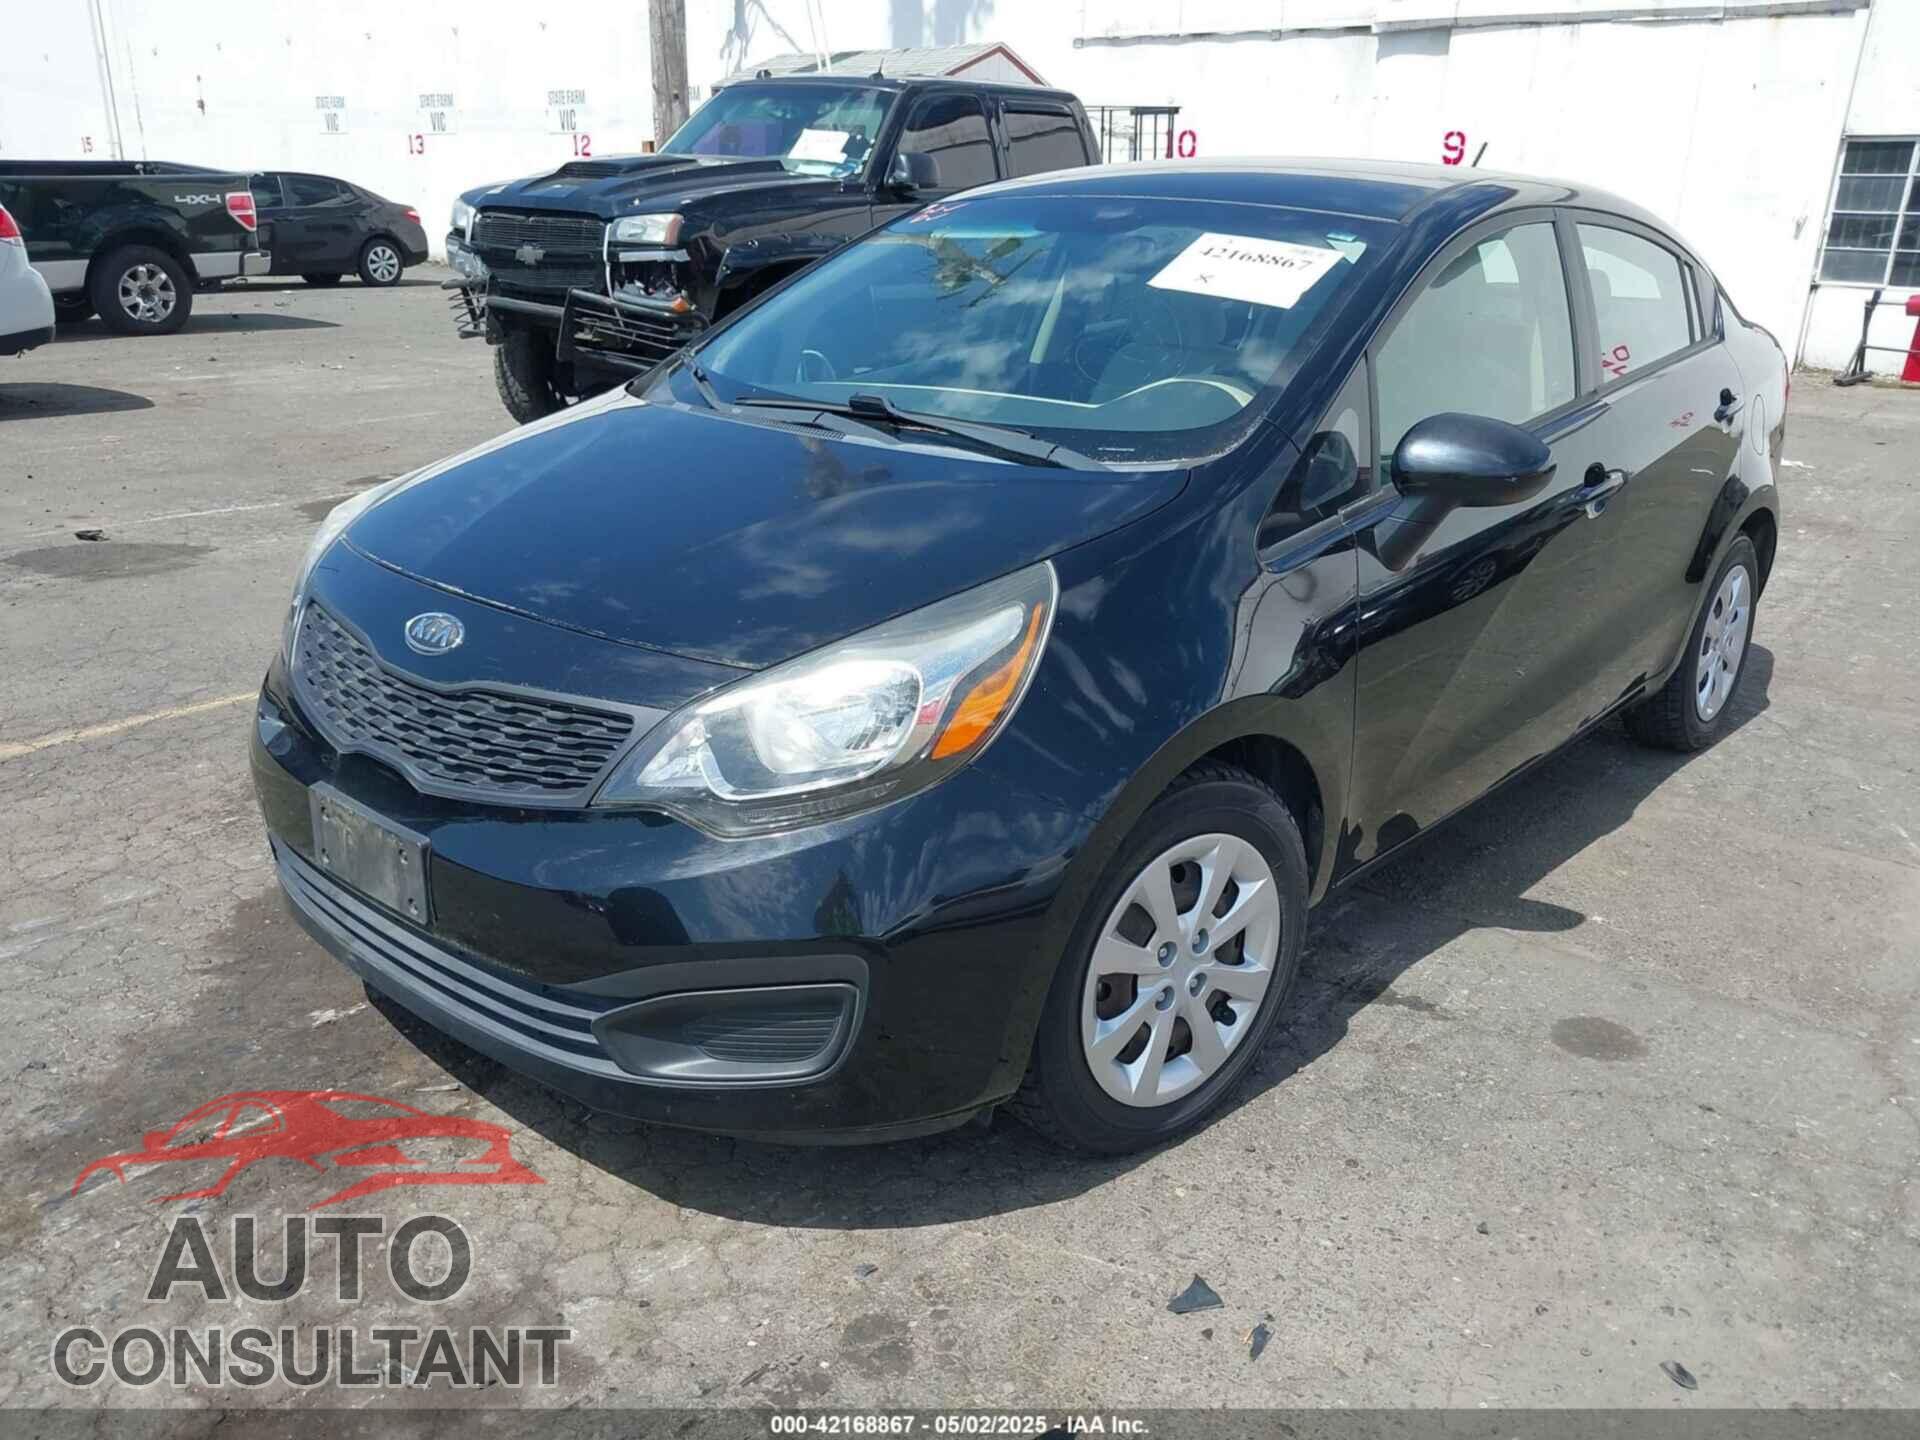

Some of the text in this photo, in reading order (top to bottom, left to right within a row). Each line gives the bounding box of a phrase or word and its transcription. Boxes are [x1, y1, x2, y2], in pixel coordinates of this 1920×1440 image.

[567, 89, 586, 104] FARM
[324, 112, 339, 132] VIC
[430, 111, 446, 132] VIC
[559, 109, 577, 131] VIC
[81, 136, 93, 154] 15
[408, 134, 425, 155] 13
[573, 134, 591, 157] 12
[1442, 131, 1466, 166] 9
